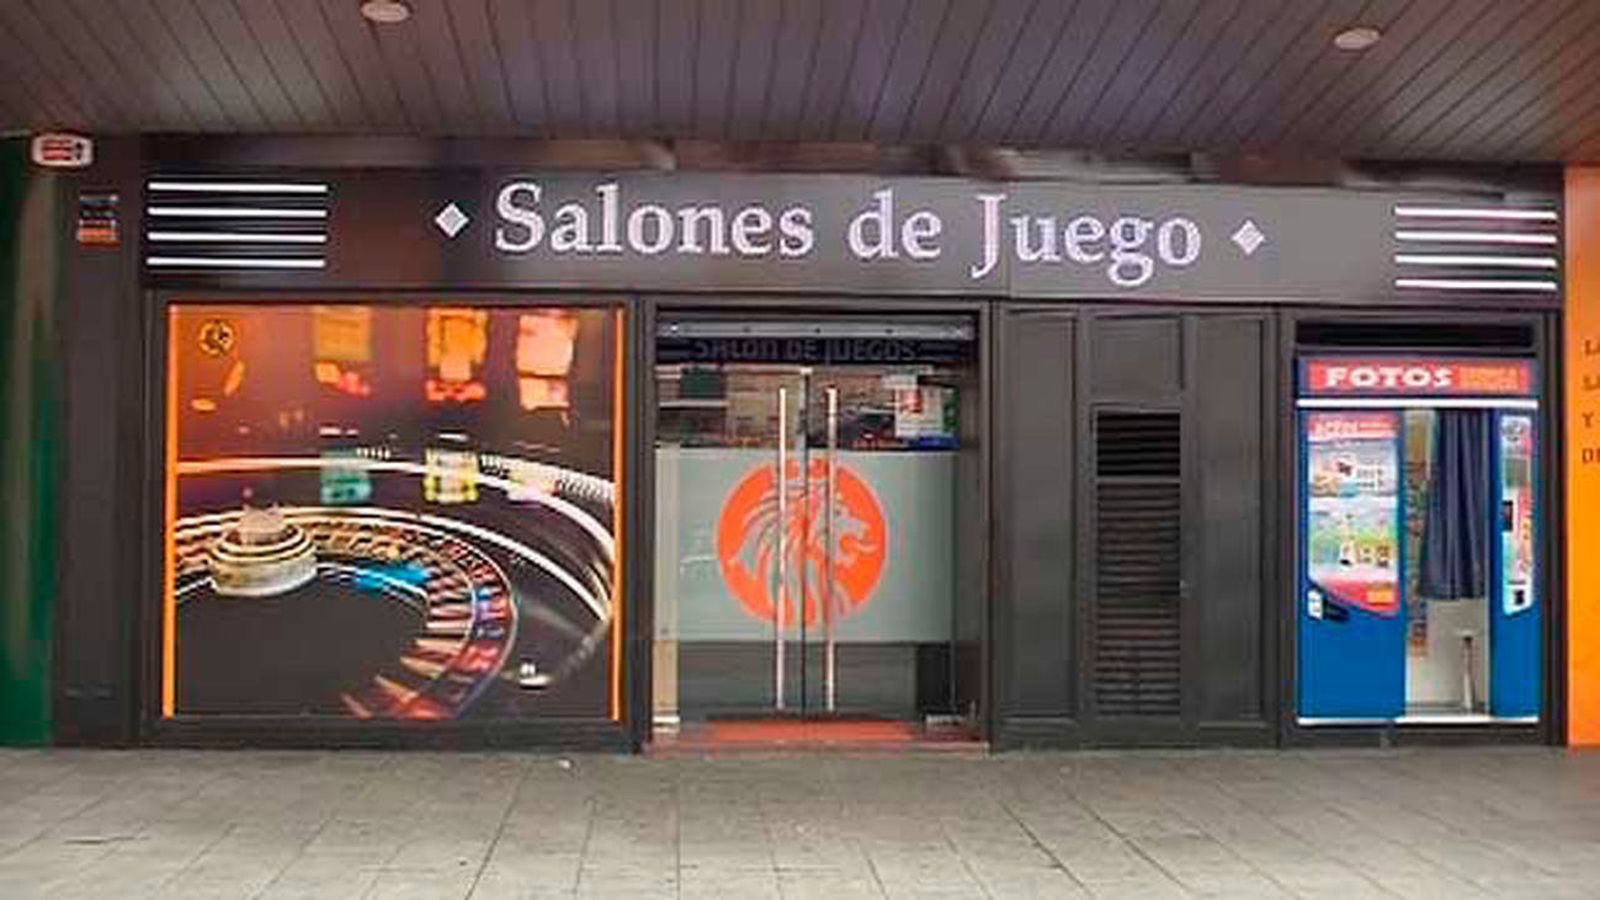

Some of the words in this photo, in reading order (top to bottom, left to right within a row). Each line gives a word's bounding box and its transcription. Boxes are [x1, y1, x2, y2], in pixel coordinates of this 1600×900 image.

[493, 183, 815, 257] Salones
[848, 189, 942, 260] de
[971, 194, 1202, 287] Juego
[1325, 366, 1451, 388] FOTOS
